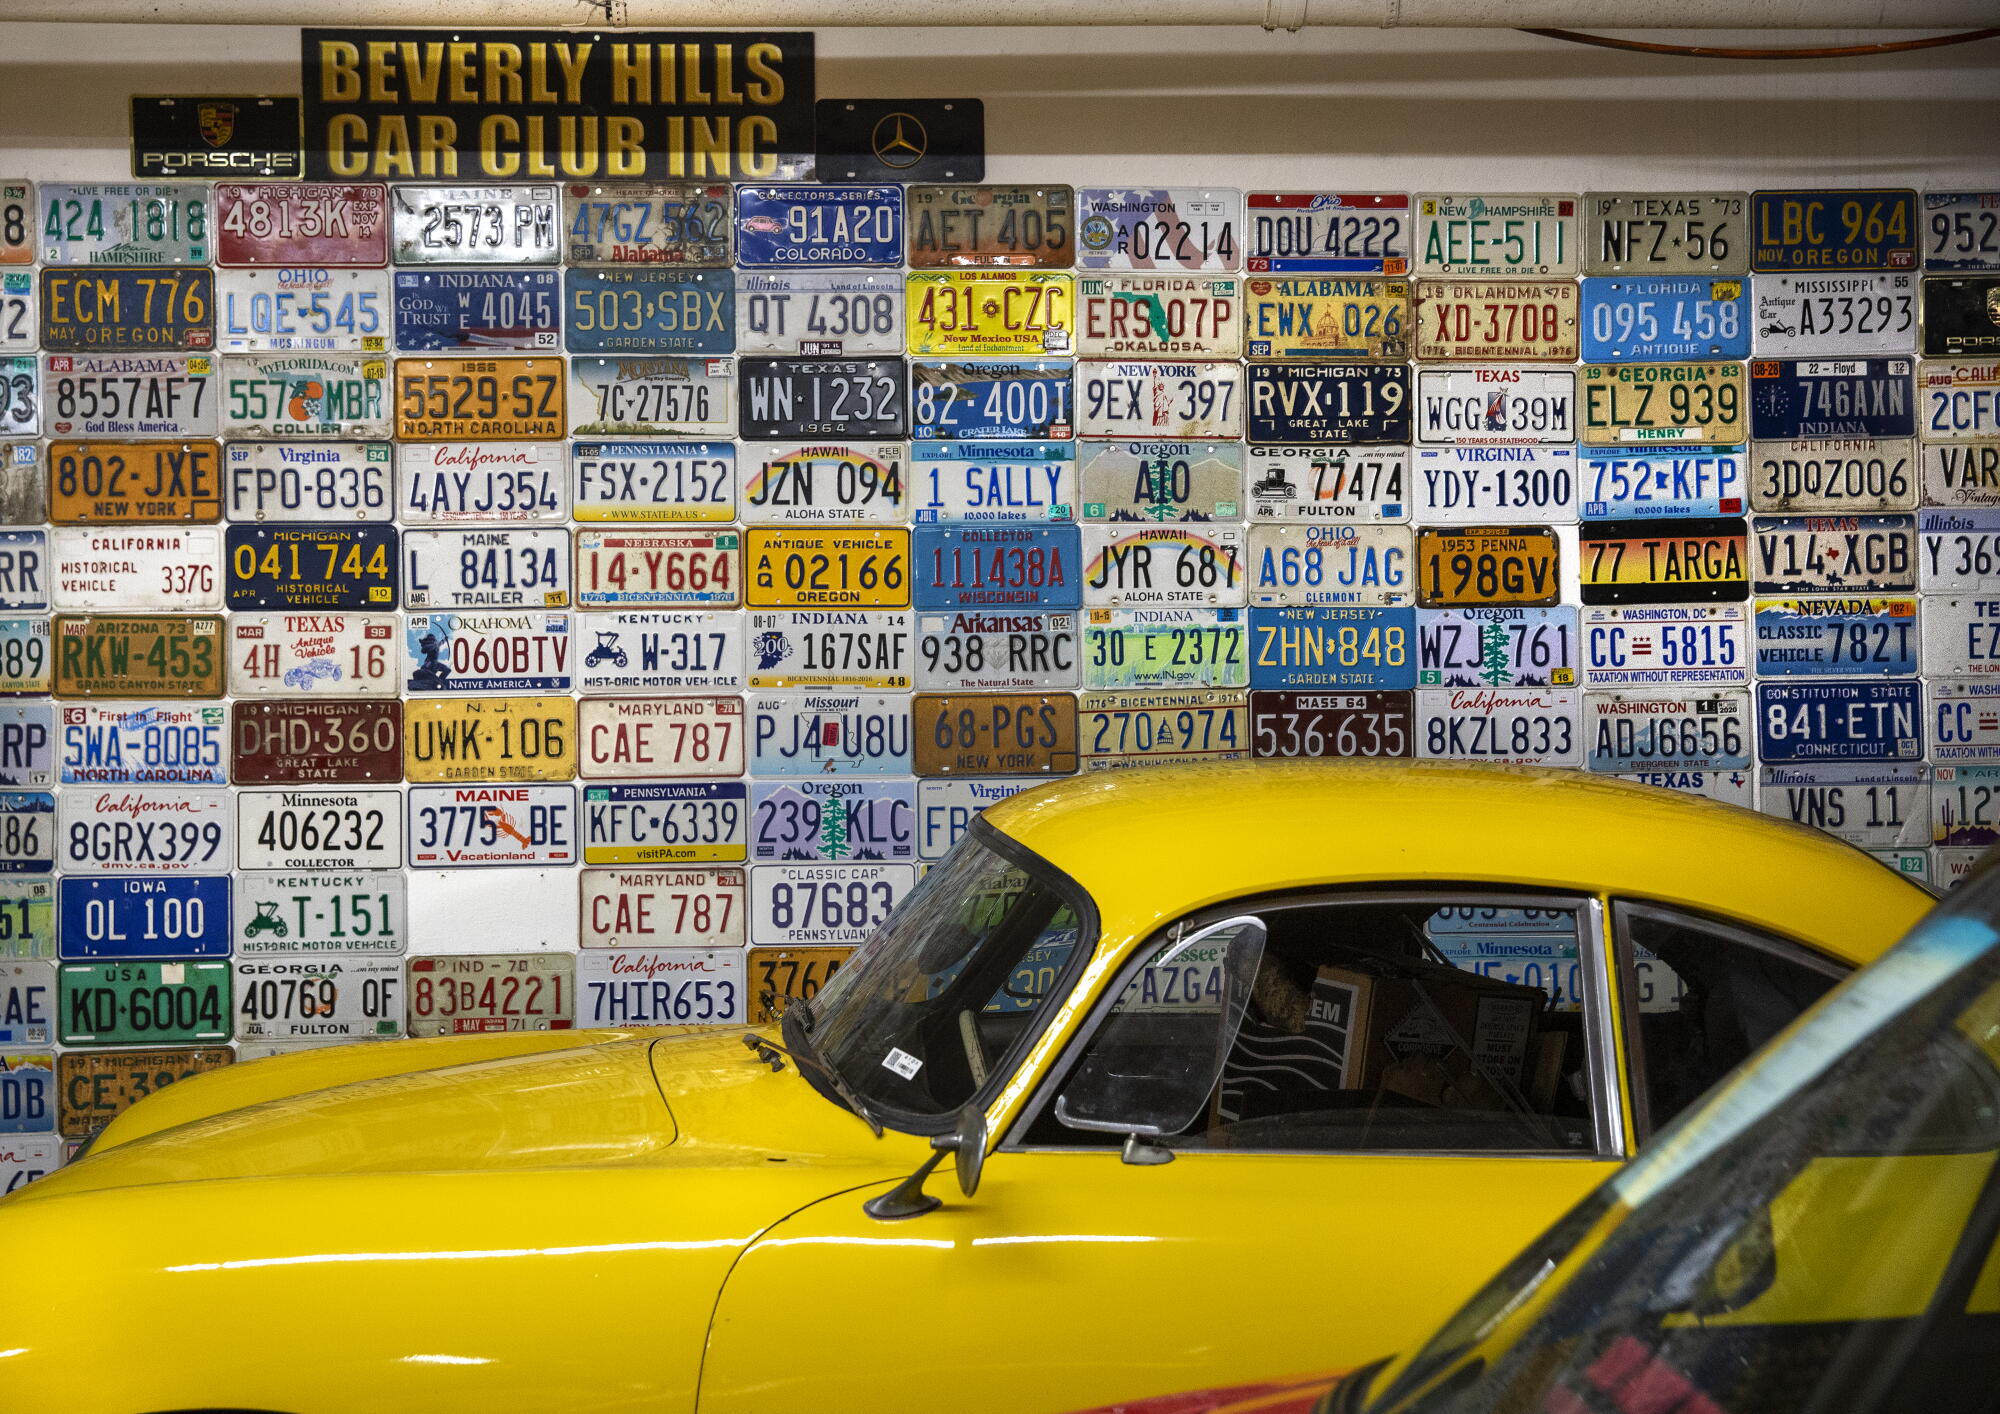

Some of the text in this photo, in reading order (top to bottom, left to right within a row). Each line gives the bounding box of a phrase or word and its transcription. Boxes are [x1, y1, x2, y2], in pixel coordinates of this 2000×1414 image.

[320, 41, 784, 105] BEVERLY HILLS
[328, 114, 779, 178] CAR CLUB INC
[143, 152, 294, 168] PORSCHE
[77, 187, 172, 196] LIVE FREE OR DIE
[260, 186, 345, 200] MICHIGAN
[1091, 202, 1176, 213] WASHINGTON
[1633, 200, 1700, 216] TEXAS
[45, 199, 206, 242] 424 1818
[224, 200, 348, 239] 4813K
[424, 205, 554, 248] 2573 PM
[789, 206, 893, 244] 91A20
[1763, 200, 1906, 246] LBC 964
[1133, 221, 1234, 261] 02214
[1424, 220, 1564, 265] AEE-511
[775, 247, 866, 261] COLORADO
[1758, 248, 1879, 265] NOV OREGON
[440, 274, 516, 288] INDIANA
[1279, 281, 1375, 297] ALABAMA
[1795, 280, 1873, 294] MISSISSIPPI
[51, 279, 205, 324] ECM 776
[482, 291, 552, 330] 4045
[749, 294, 894, 337] QT 4308
[1800, 296, 1912, 336] A33293
[1258, 303, 1400, 338] EWX 026
[1435, 304, 1558, 343] XD-3708
[1592, 301, 1740, 342] 095 458
[49, 327, 173, 343] MAY OREGON
[944, 334, 1039, 343] New Mexico USA
[1252, 343, 1269, 356] SEP
[1632, 343, 1699, 356] ANTIQUE
[53, 360, 70, 371] APR
[85, 360, 177, 373] ALABAMA
[789, 364, 857, 374] TEXAS
[57, 378, 206, 419] 8557AF7
[1586, 384, 1738, 427] ELZ 939
[1799, 380, 1904, 418] 746AXN
[85, 421, 178, 433] God Bless America
[404, 422, 556, 435] NORTH CAROLINA
[1637, 428, 1685, 440] HENRY
[1800, 422, 1867, 433] INDIANA
[279, 448, 340, 465] Virginia
[434, 447, 538, 471] California
[801, 447, 850, 458] HAWAII
[1456, 448, 1535, 462] VIRGINIA
[749, 462, 902, 505] JZN 094
[1762, 459, 1907, 498] 3DQZ006
[410, 472, 558, 512] 4AYJ354
[966, 466, 1063, 508] SALLY
[1424, 469, 1571, 508] YDY-1300
[94, 502, 176, 516] NEW YORK
[1257, 508, 1274, 517] APR
[1298, 506, 1356, 516] FULTON
[463, 534, 510, 546] MAINE
[1140, 530, 1187, 540] HAWAII
[92, 538, 181, 551] CALIFORNIA
[763, 540, 893, 550] ANTIQUE VEHICLE
[61, 562, 138, 574] HISTORICAL
[234, 543, 388, 584] 041 744
[461, 547, 558, 589] 84134
[1089, 544, 1237, 589] JYR 687
[1259, 547, 1404, 588] A68 JAG
[1588, 540, 1742, 582] 77 TARGA
[161, 565, 213, 594] 337G
[785, 554, 903, 590] 02166
[1428, 554, 1548, 599] 198GV
[61, 580, 116, 592] VEHICLE
[452, 592, 523, 605] TRAILER
[797, 591, 860, 602] OREGON
[1306, 592, 1362, 603] CLERMONT
[1623, 609, 1707, 621] WASHINGTON, DC
[1797, 600, 1873, 617] NEVADA
[618, 614, 704, 624] KENTUCKY
[792, 612, 868, 625] INDIANA
[1758, 626, 1822, 640] CLASSIC
[1590, 625, 1735, 667] CC 5815
[1827, 622, 1912, 663] 782T
[62, 636, 213, 679] RKW-453
[453, 636, 568, 675] 060BTV
[642, 633, 723, 673] W-317
[803, 633, 909, 670] 167SAF
[1759, 648, 1824, 662] VEHICLE
[1134, 670, 1196, 682] www.IN.gov
[1588, 669, 1745, 683] TAXATION WITHOUT REPRESENTATION
[449, 679, 532, 690] NATIVE AMERICA
[619, 703, 704, 716] MARYLAND
[758, 701, 779, 710] AUG
[1297, 697, 1366, 708] MASS 64
[1597, 702, 1687, 714] WASHINGTON
[590, 722, 731, 764] CAE 787
[1427, 716, 1572, 756] 8KZL833
[1596, 717, 1742, 758] ADJ6656
[65, 725, 221, 767] SWA-8085
[1796, 743, 1886, 756] CONNECTICUT
[282, 794, 358, 807] Minnesota
[456, 790, 529, 802] MAINE
[624, 788, 706, 798] PENNSYLVANIA
[96, 793, 201, 818] California
[1788, 786, 1905, 827] VNS 11
[258, 811, 384, 852] 406232
[420, 804, 567, 848] 3775 BE
[70, 821, 221, 862] 8GRX399
[285, 858, 355, 867] COLLECTOR
[446, 850, 536, 862] Vacationland
[102, 862, 189, 870] dmv.ca.gov
[621, 873, 705, 888] MARYLAND
[788, 869, 878, 880] CLASSIC CAR
[124, 881, 167, 893] IOWA
[772, 882, 893, 929] 87683
[144, 898, 204, 939] 100
[592, 892, 733, 936] CAE 787
[1476, 942, 1552, 956] Minnesota
[238, 964, 343, 975] GEORGIA
[240, 979, 398, 1021] 40769 QF
[587, 982, 735, 1023] 7HIR653
[246, 1024, 263, 1035] JUL
[291, 1025, 350, 1035] FULTON
